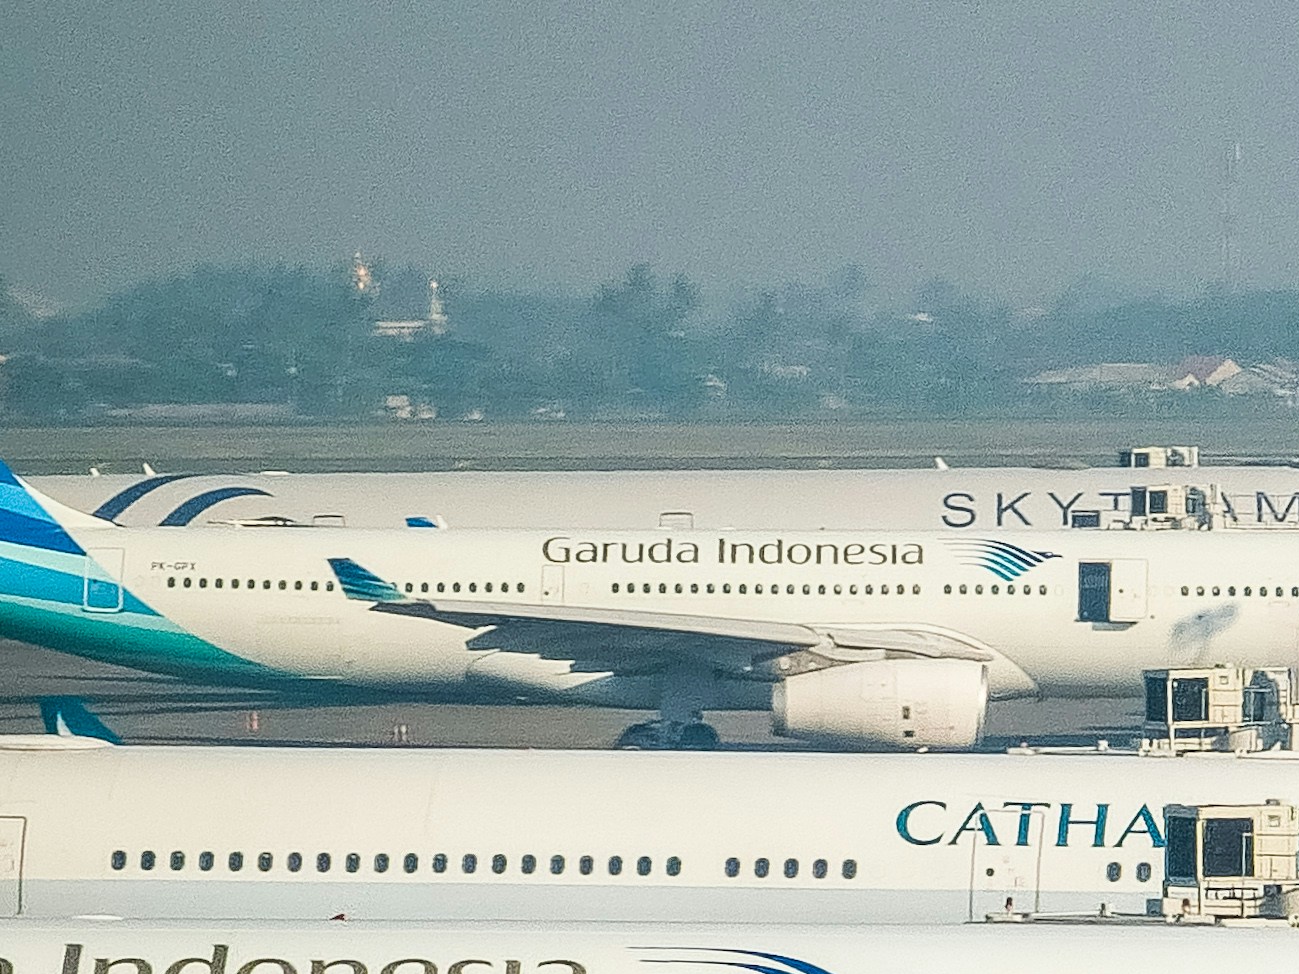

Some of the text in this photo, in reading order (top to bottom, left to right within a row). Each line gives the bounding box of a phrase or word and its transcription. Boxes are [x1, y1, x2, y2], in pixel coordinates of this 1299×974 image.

[542, 536, 924, 565] Garuda Indonesia
[895, 800, 1166, 848] CATHA
